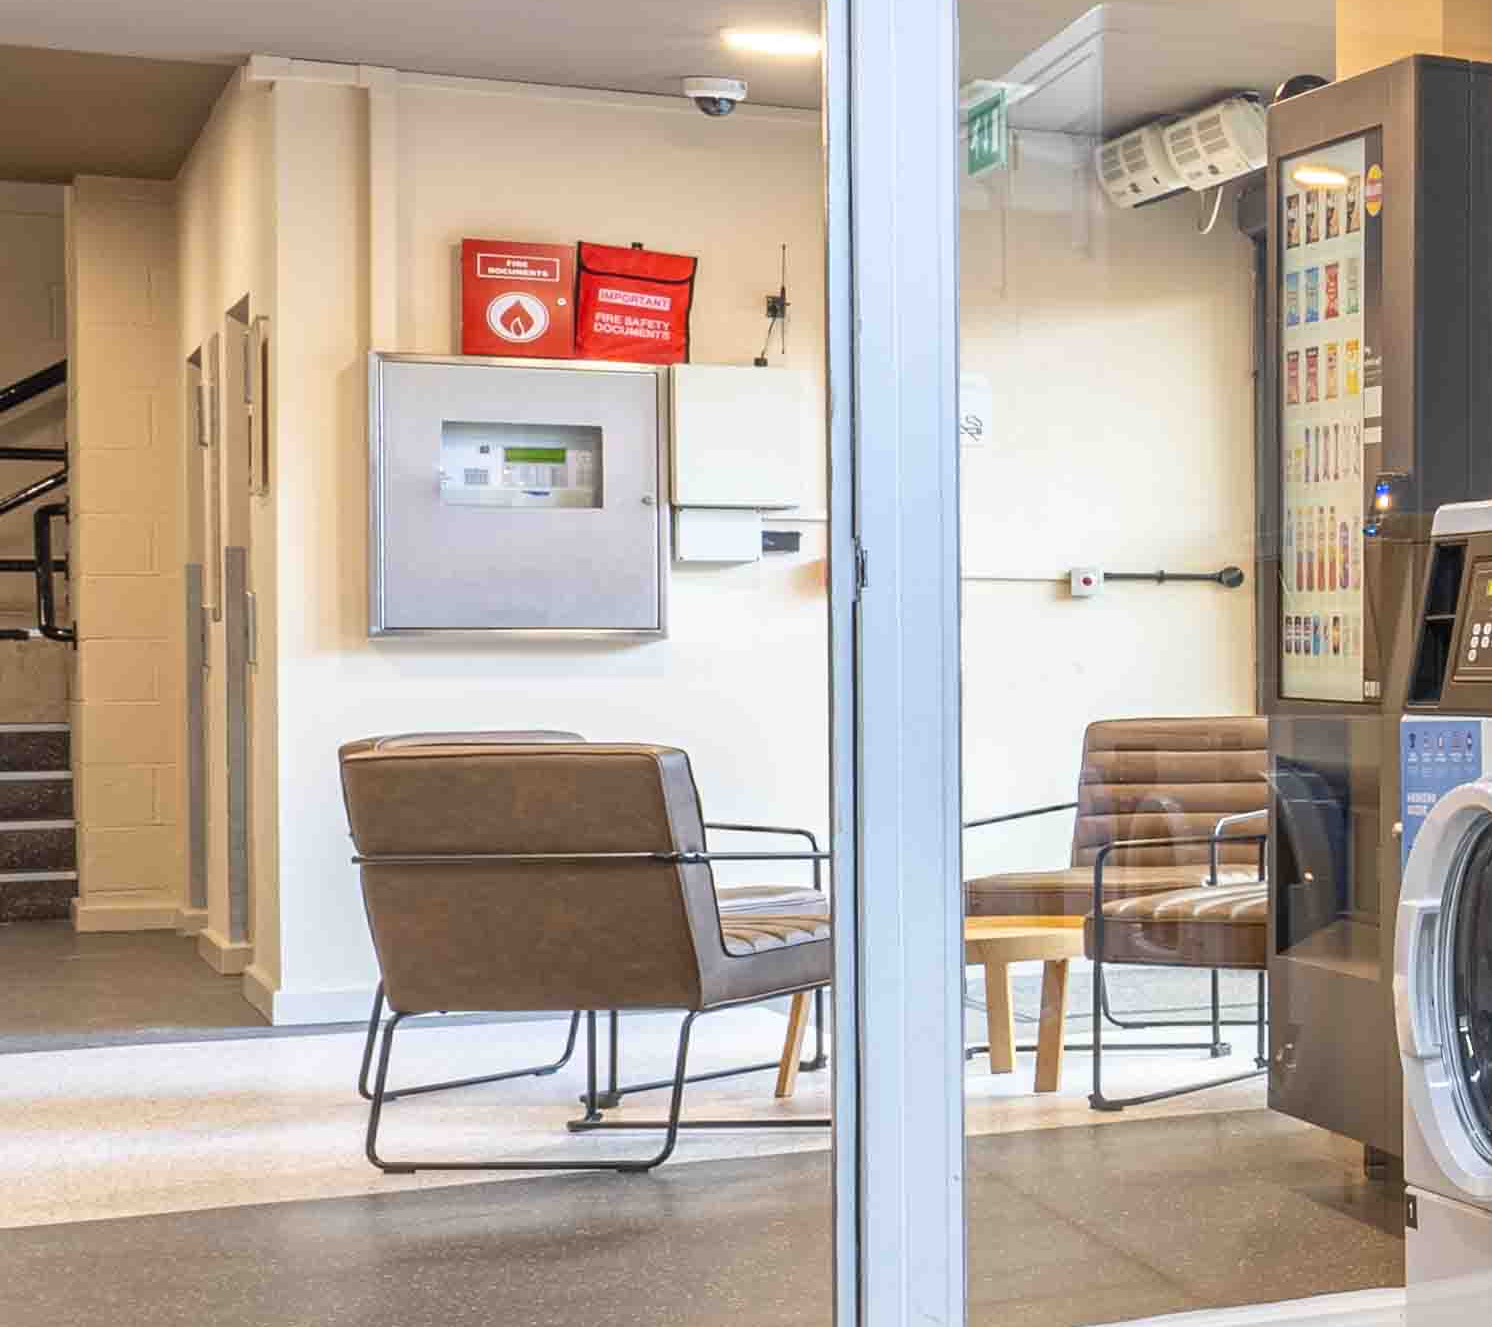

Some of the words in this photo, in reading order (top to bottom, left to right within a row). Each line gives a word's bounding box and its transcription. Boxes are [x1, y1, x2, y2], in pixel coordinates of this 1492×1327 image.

[600, 290, 670, 309] IMPORTANT
[595, 312, 622, 325] FIRE
[624, 316, 669, 331] SAFETY
[593, 324, 670, 340] DOCUMENTS
